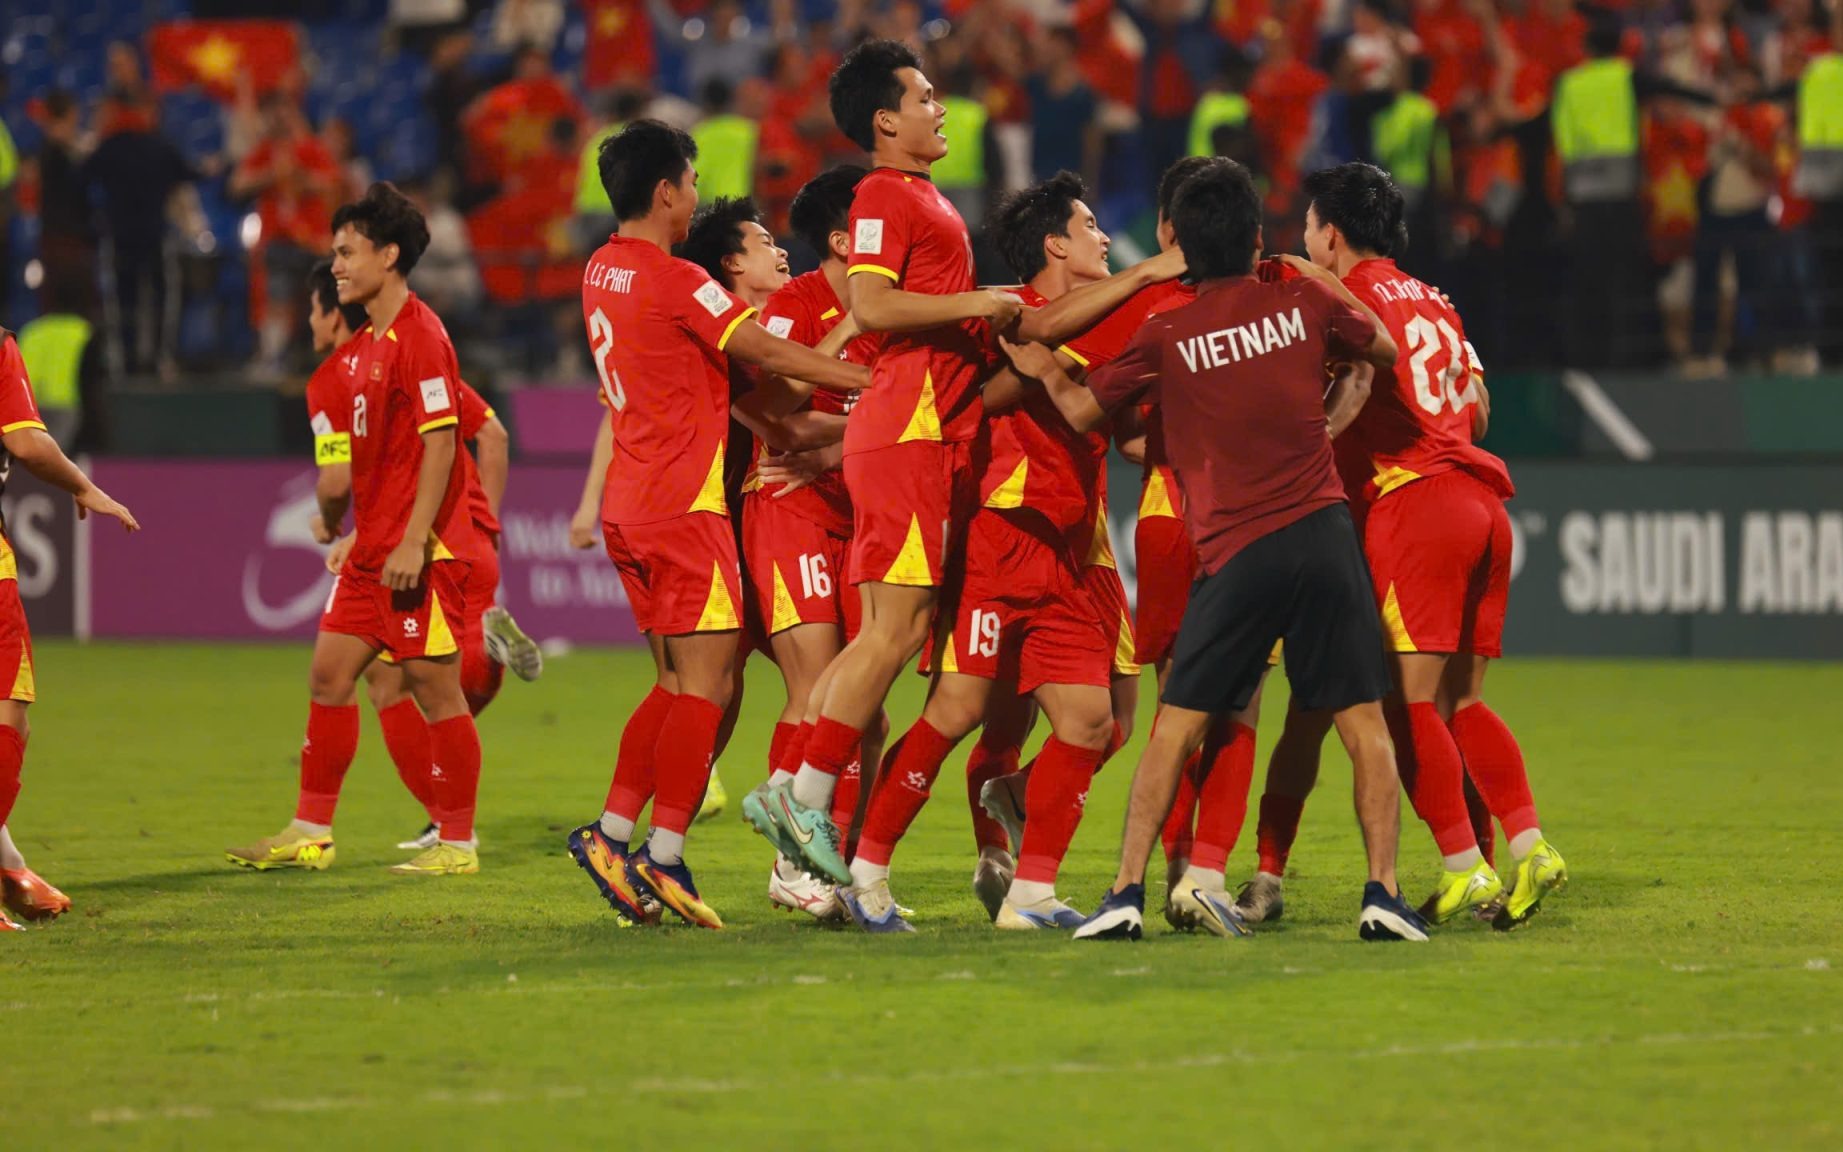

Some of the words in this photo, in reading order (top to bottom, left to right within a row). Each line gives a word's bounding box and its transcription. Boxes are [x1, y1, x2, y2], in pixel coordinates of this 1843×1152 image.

[602, 267, 636, 294] PHAT
[589, 306, 627, 412] 2
[1176, 307, 1307, 374] VIETNAM
[319, 440, 349, 457] AFC
[799, 553, 832, 599] 16
[1559, 510, 1726, 614] SAUDI
[968, 608, 1001, 658] 19
